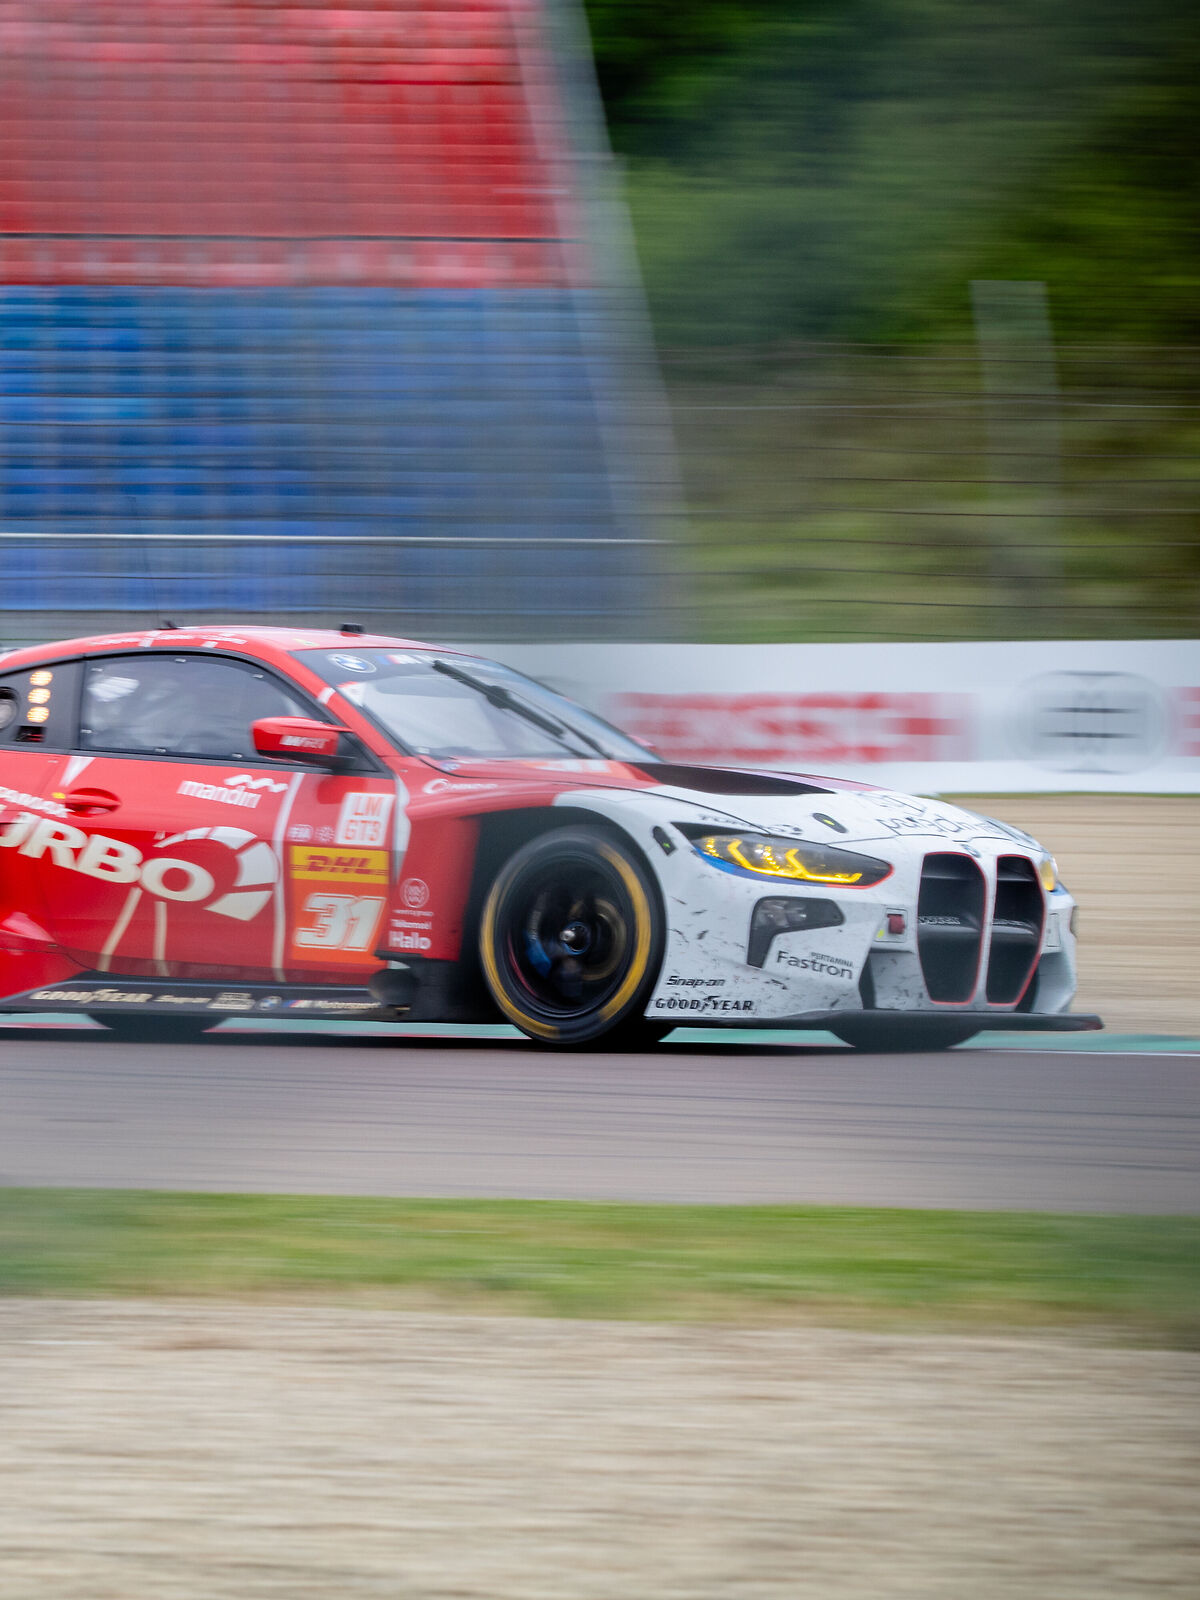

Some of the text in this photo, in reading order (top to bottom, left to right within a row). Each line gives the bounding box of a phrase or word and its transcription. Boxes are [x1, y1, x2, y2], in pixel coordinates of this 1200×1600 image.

[353, 796, 384, 817] LM
[305, 854, 371, 875] DHL
[294, 892, 387, 950] 31
[389, 930, 432, 950] Halo
[775, 950, 853, 980] Fastron
[666, 975, 726, 987] Snap-on
[655, 995, 754, 1011] GOODYEAR
